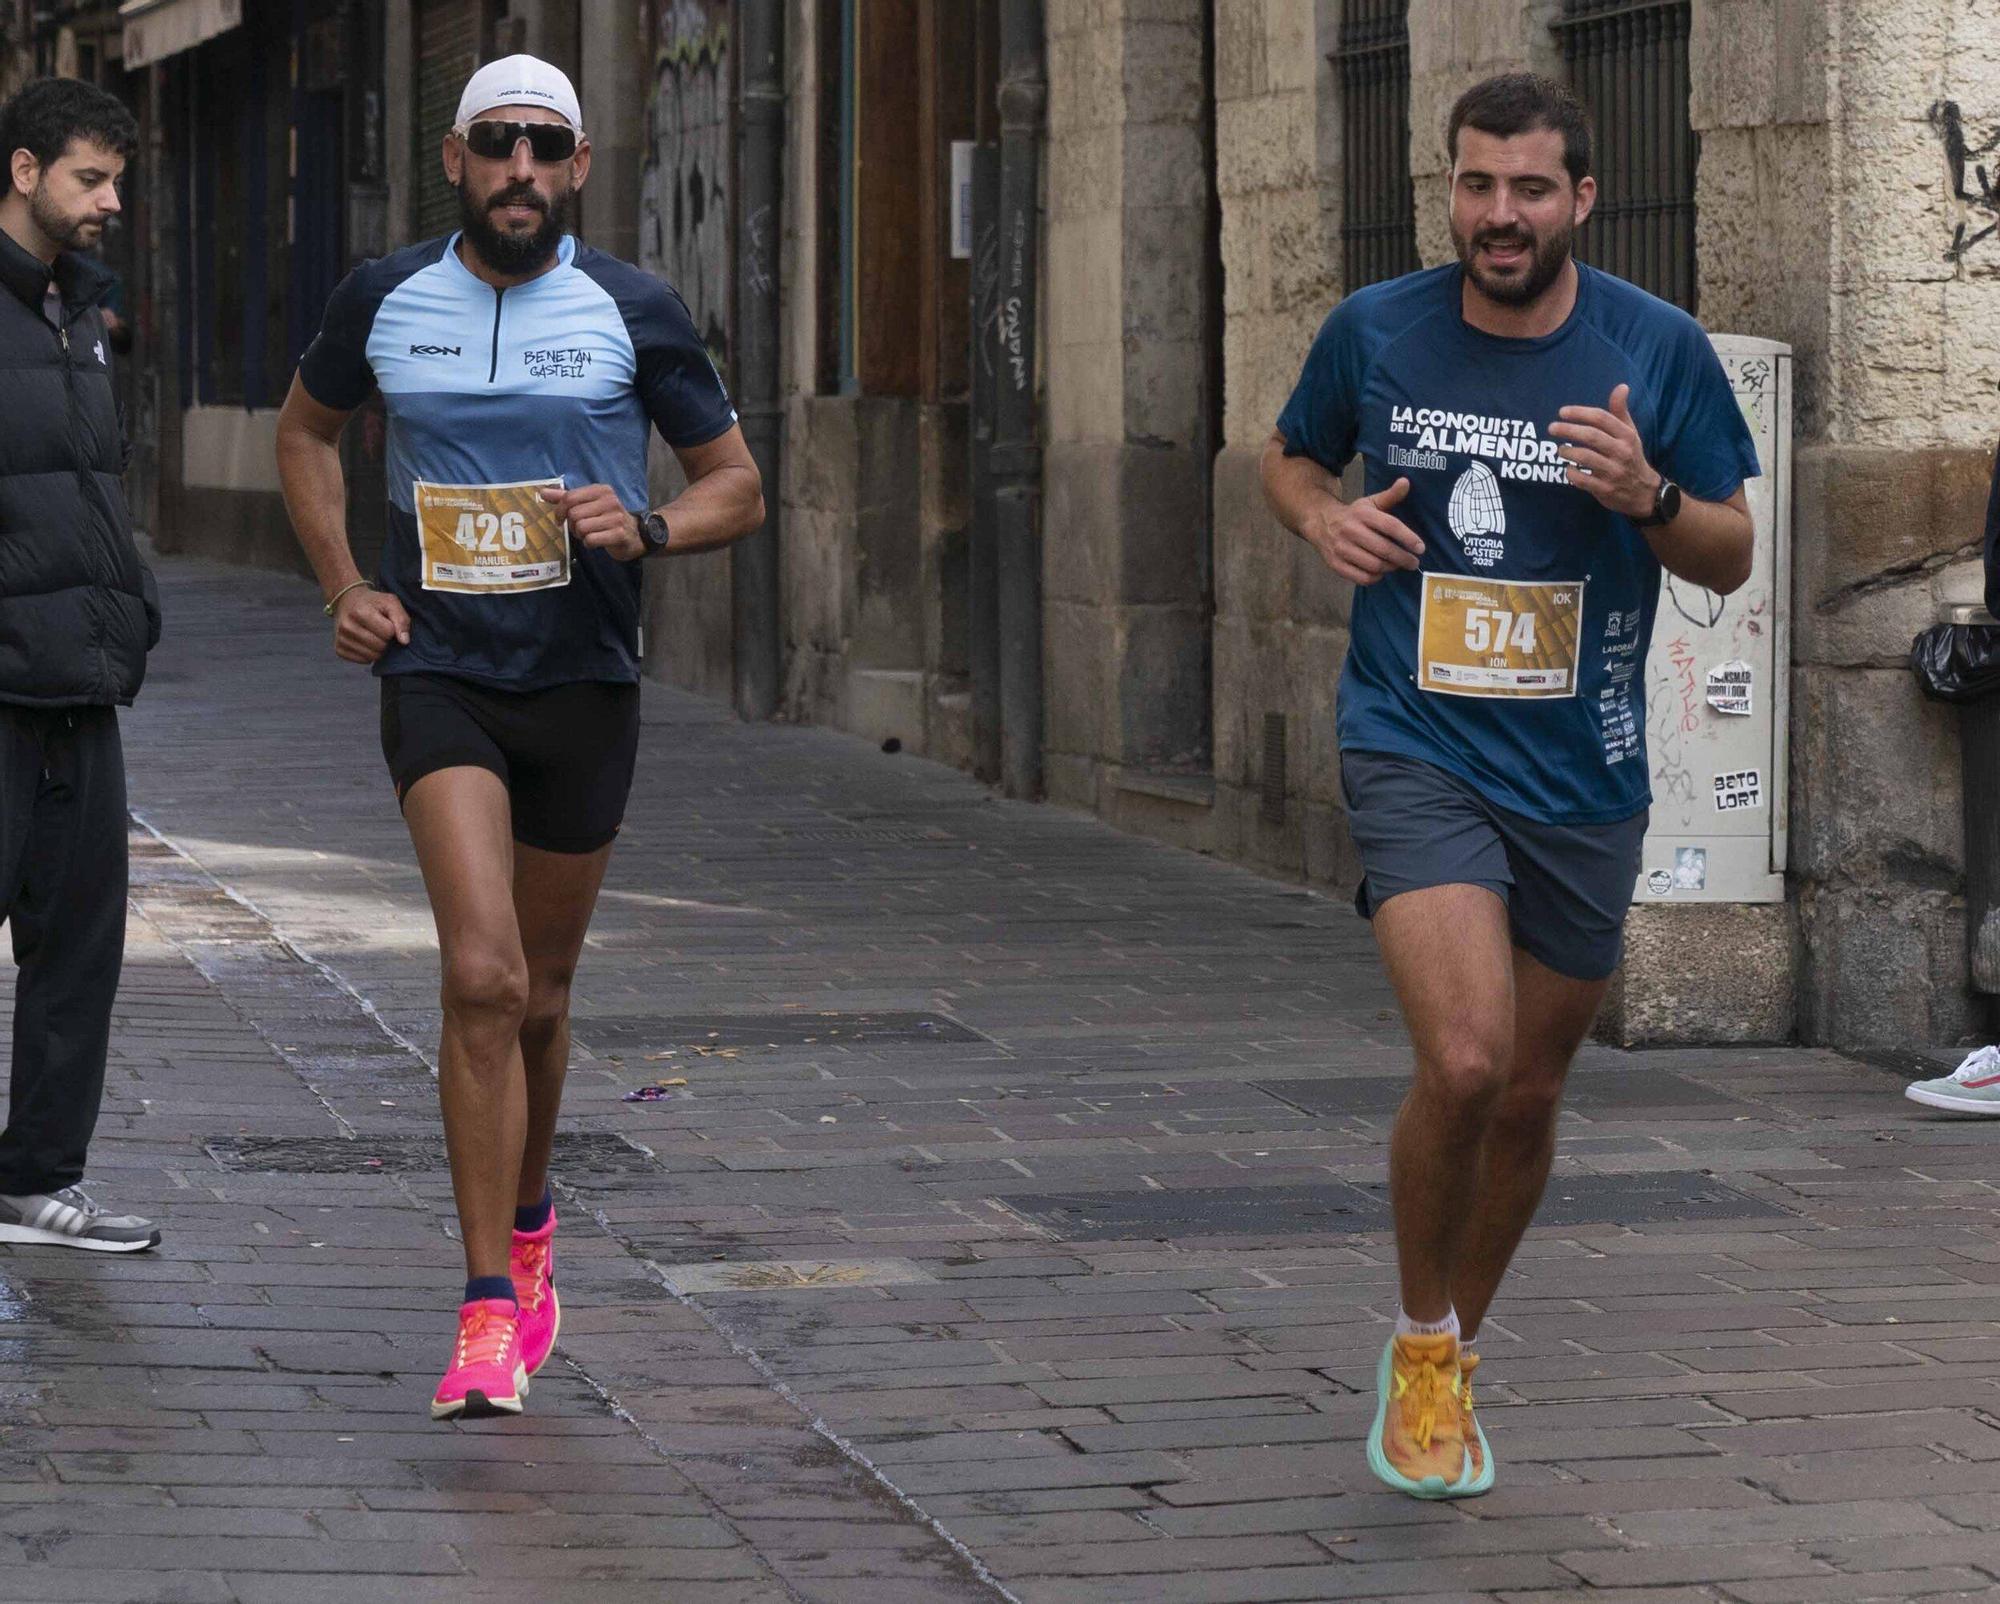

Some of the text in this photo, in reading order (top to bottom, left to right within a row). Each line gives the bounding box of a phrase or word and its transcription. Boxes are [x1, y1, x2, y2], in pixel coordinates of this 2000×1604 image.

[497, 90, 555, 101] UNDER ARMOUR
[524, 349, 592, 366] BENETAN
[1389, 422, 1405, 433] DE
[1405, 424, 1421, 435] LA
[1391, 405, 1537, 439] LA CONQUISTA
[1399, 446, 1447, 471] Edición
[455, 511, 527, 552] 426
[1463, 537, 1504, 549] VITORIA
[1463, 547, 1504, 560] GASTEIZ
[474, 555, 511, 566] MANUEL
[1472, 557, 1494, 567] 2025
[1553, 593, 1572, 605] 10K
[1465, 608, 1537, 655] 574
[1490, 657, 1508, 668] ION
[1716, 790, 1760, 811] LORT
